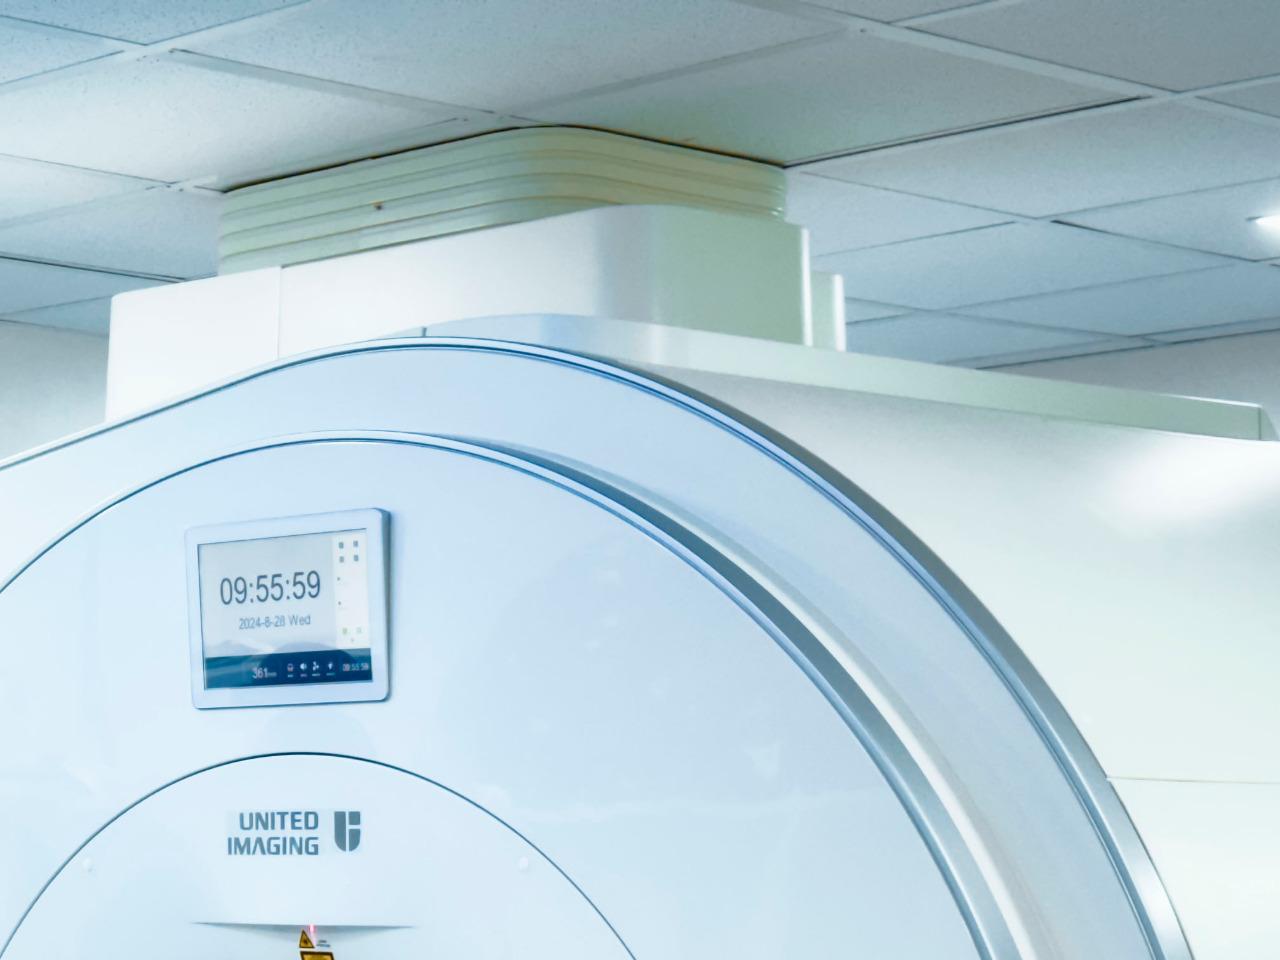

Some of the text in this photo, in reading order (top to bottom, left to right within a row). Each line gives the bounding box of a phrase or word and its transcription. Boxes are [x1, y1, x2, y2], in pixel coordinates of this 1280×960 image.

[220, 570, 321, 605] 09:55:59
[289, 614, 310, 626] Wed
[239, 811, 319, 831] UNITED
[227, 836, 319, 855] IMAGING
